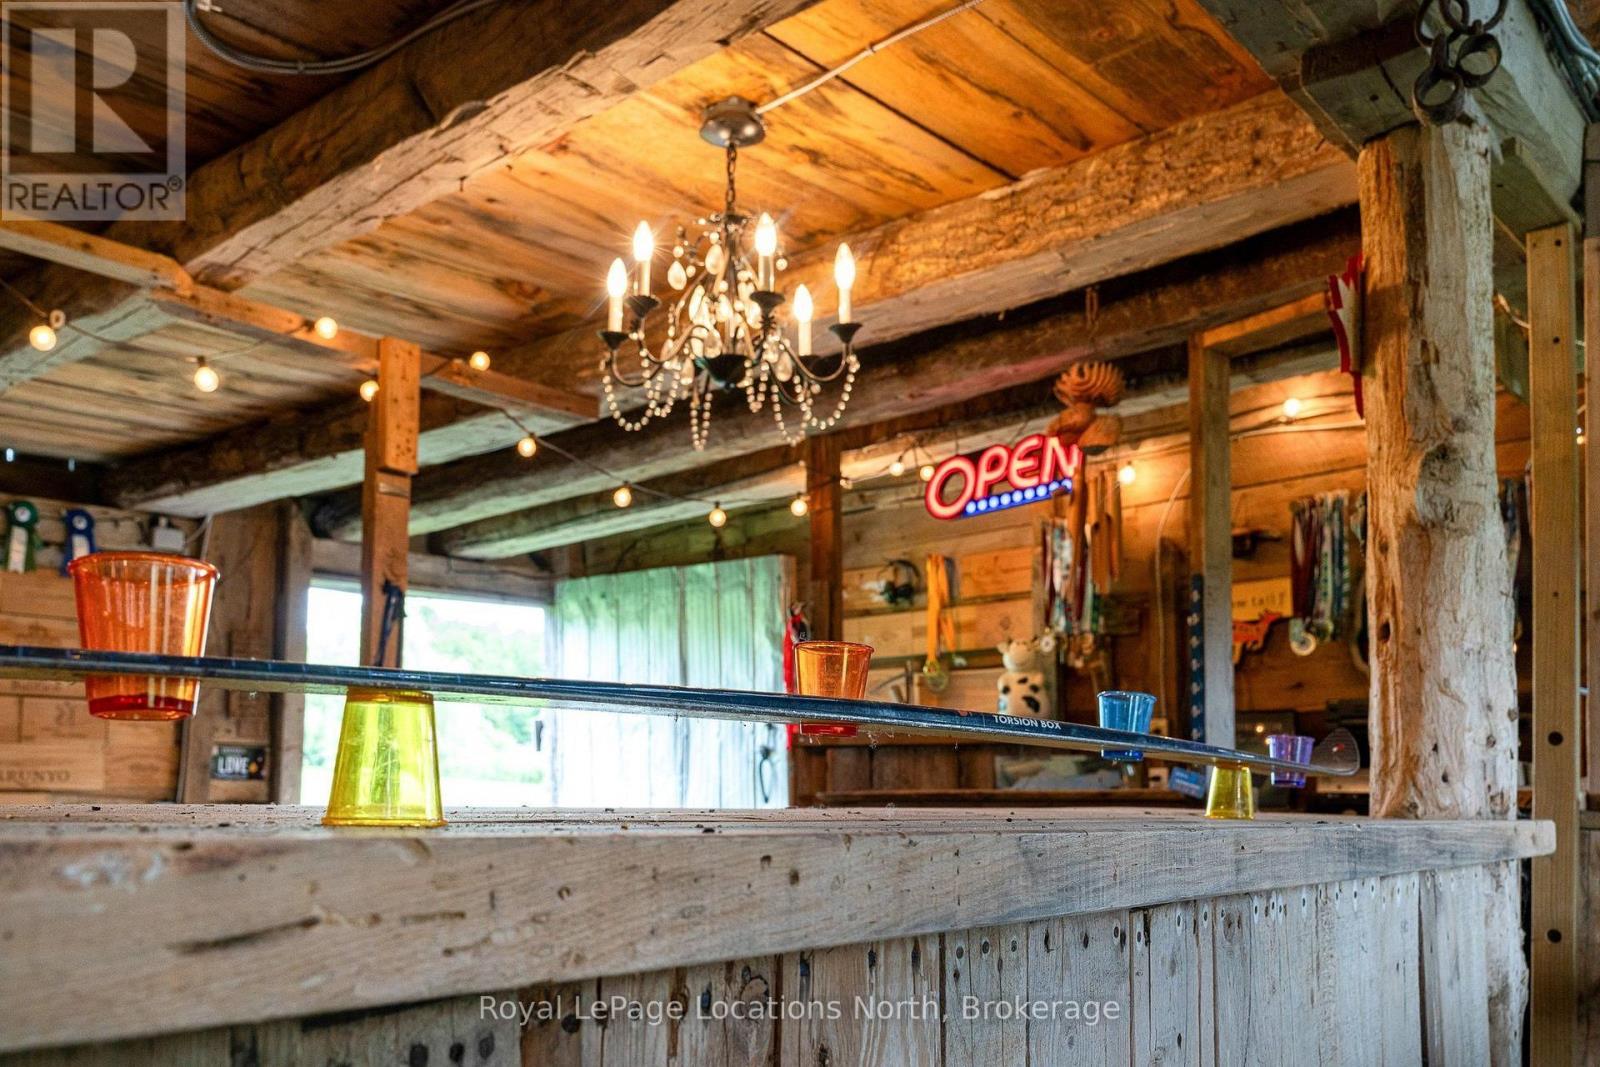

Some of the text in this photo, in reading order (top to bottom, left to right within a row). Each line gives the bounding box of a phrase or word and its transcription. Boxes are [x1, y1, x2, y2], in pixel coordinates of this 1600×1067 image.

[925, 433, 1083, 520] OPEN
[992, 714, 1062, 730] TORSION BOX
